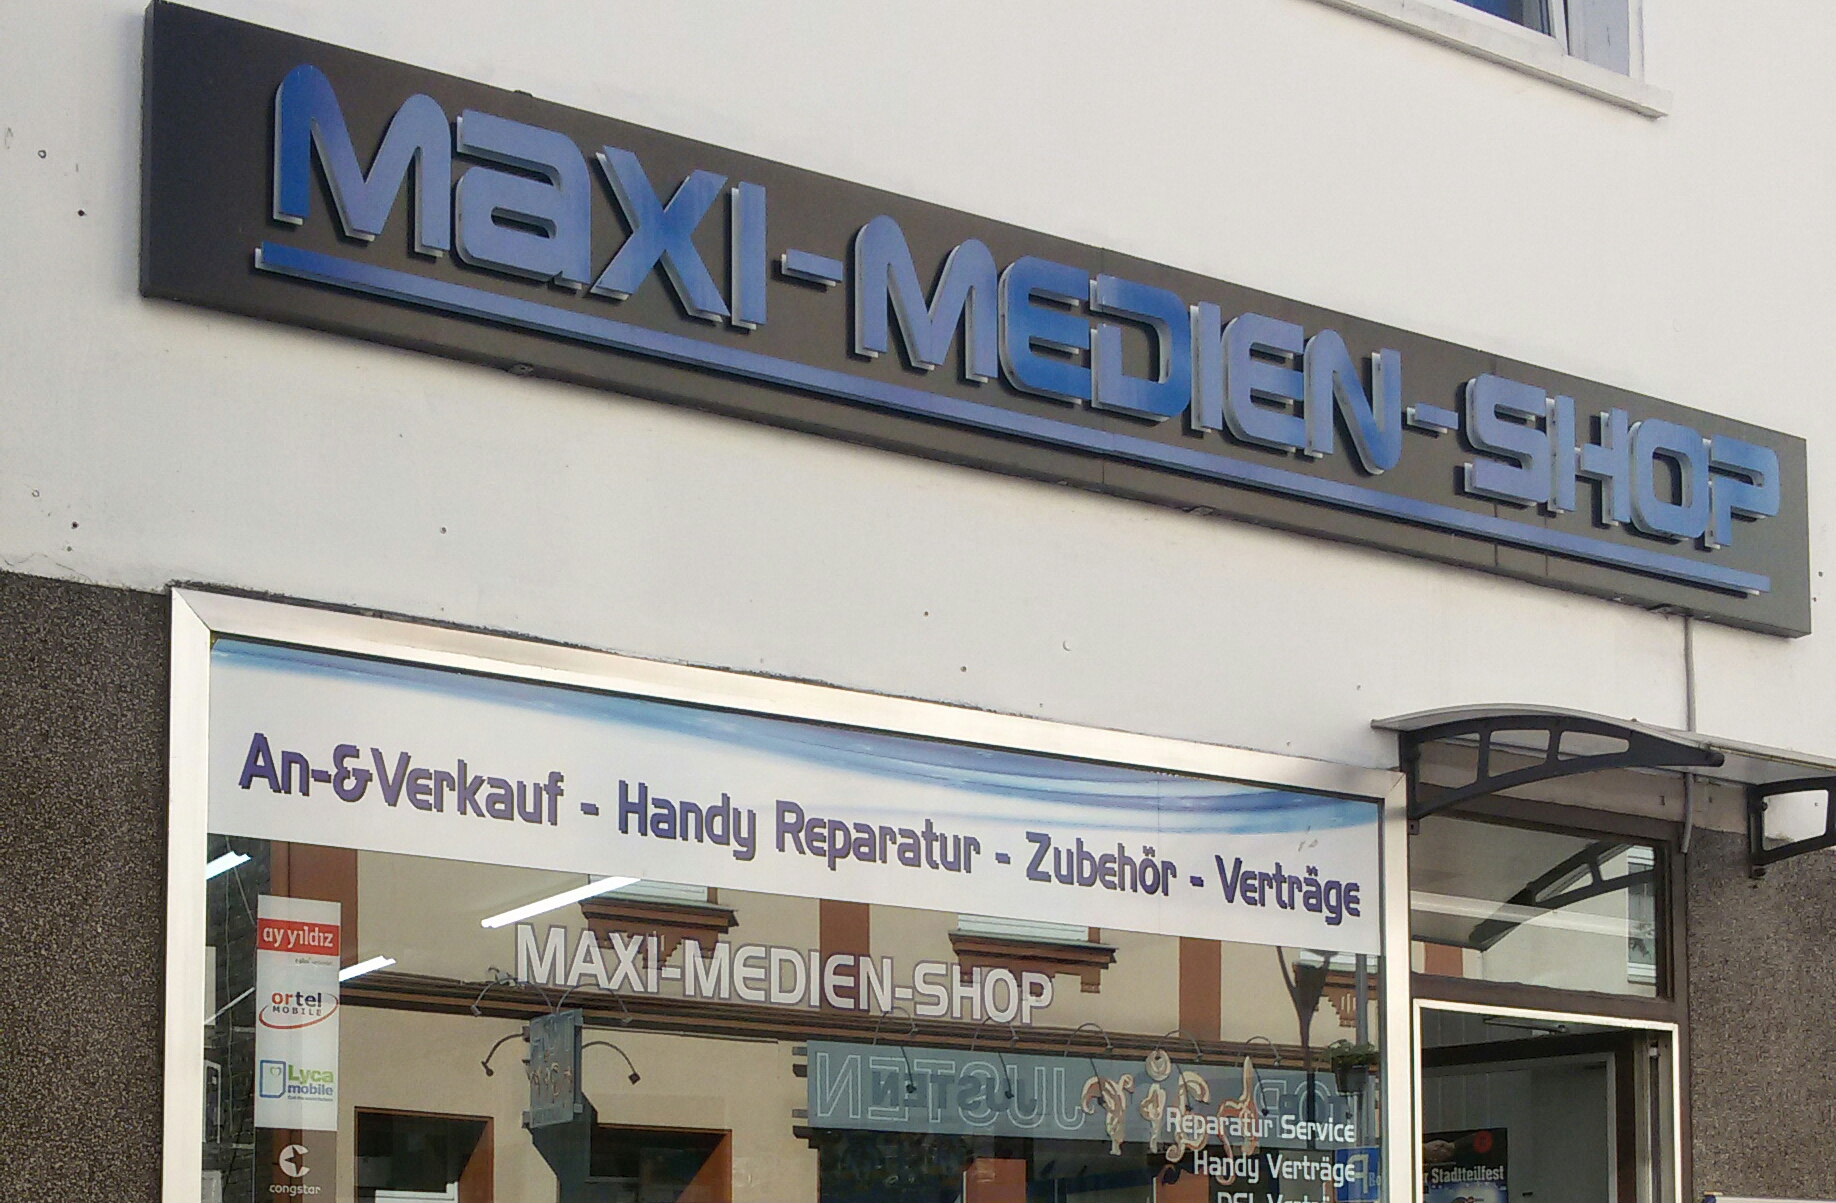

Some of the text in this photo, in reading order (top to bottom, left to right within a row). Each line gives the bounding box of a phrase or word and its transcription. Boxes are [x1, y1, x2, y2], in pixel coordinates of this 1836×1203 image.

[239, 731, 1361, 926] An-&Verkauf - Handy Reparatur - Zubehör - Verträge
[263, 926, 284, 948] ay
[515, 922, 1055, 1026] MAXI-MEDIEN-SHOP
[271, 991, 323, 1008] ortel
[272, 1005, 322, 1017] MOBILE
[288, 1063, 334, 1086] Lyca
[287, 1082, 334, 1097] mobile
[1166, 1107, 1356, 1143] Reparatur Service
[1193, 1149, 1356, 1188] Handy Verträge
[1431, 1165, 1504, 1184] Stadtteilfest
[268, 1184, 321, 1197] congstar
